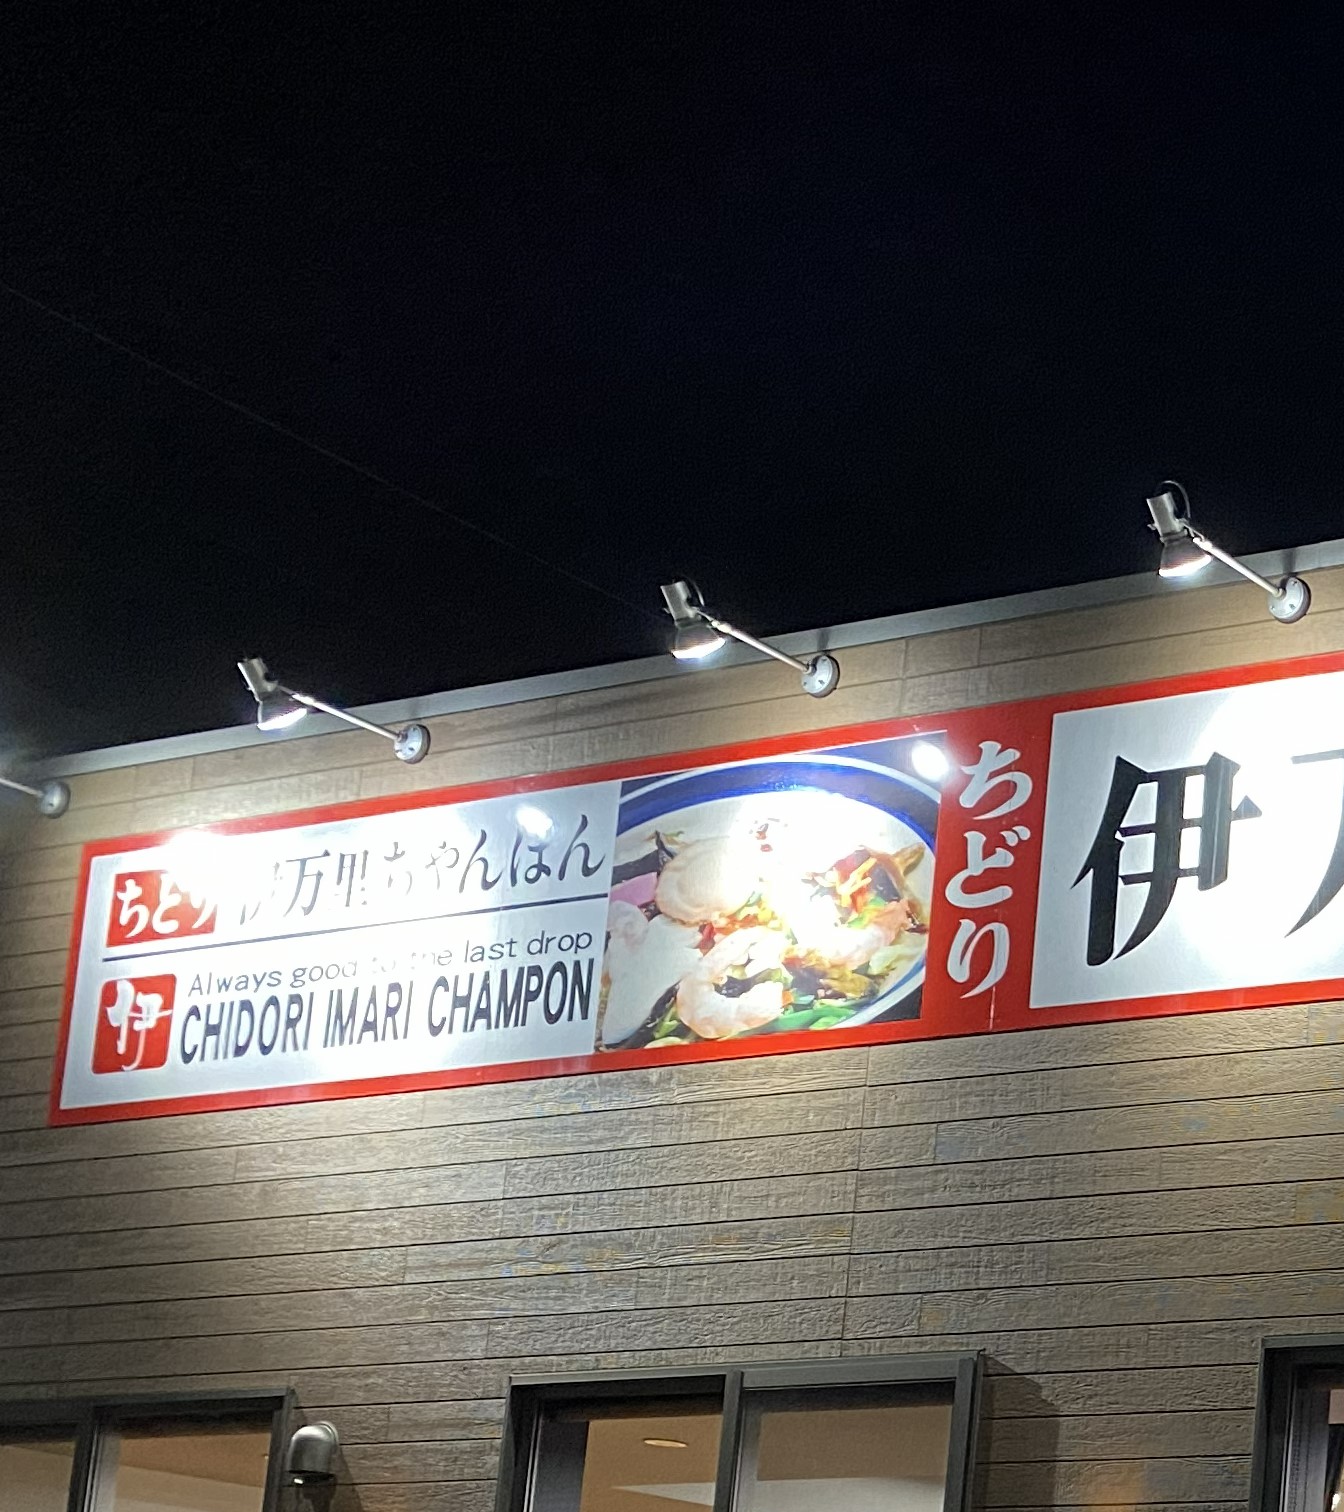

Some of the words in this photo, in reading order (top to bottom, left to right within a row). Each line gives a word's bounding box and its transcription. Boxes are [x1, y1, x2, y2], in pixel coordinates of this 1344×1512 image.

[945, 741, 1033, 999] ちどり
[181, 992, 315, 1064] CHIDORI
[323, 980, 414, 1048] IMARI
[428, 958, 594, 1037] CHAMPON
[188, 970, 282, 998] Always
[464, 940, 518, 963] last
[527, 930, 593, 954] drop
